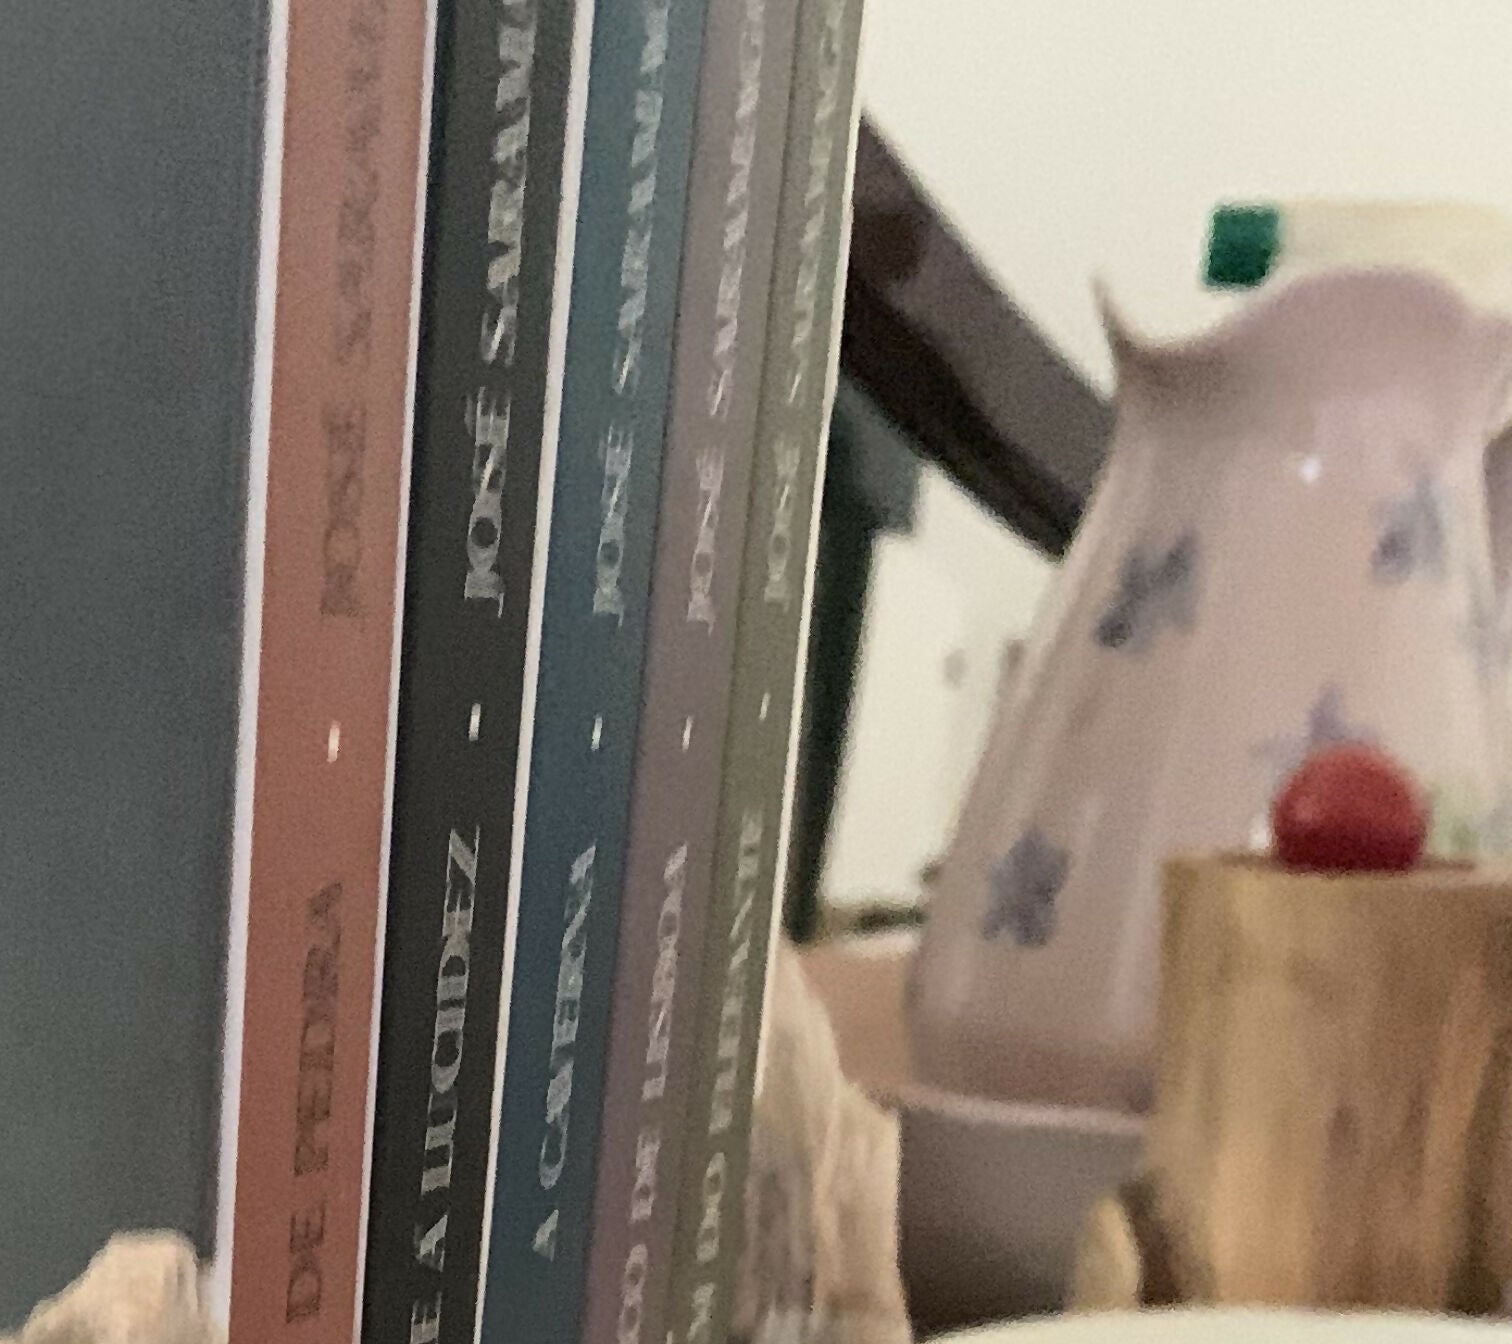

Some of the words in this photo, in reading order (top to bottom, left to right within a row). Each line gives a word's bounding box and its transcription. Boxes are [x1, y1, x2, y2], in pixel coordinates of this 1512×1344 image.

[463, 386, 512, 619] JOSÉ
[292, 881, 344, 1177] PEDRA
[421, 824, 481, 1196] LUCIDEZ
[286, 1202, 326, 1324] DE
[413, 1213, 449, 1272] A
[531, 1208, 560, 1263] A
